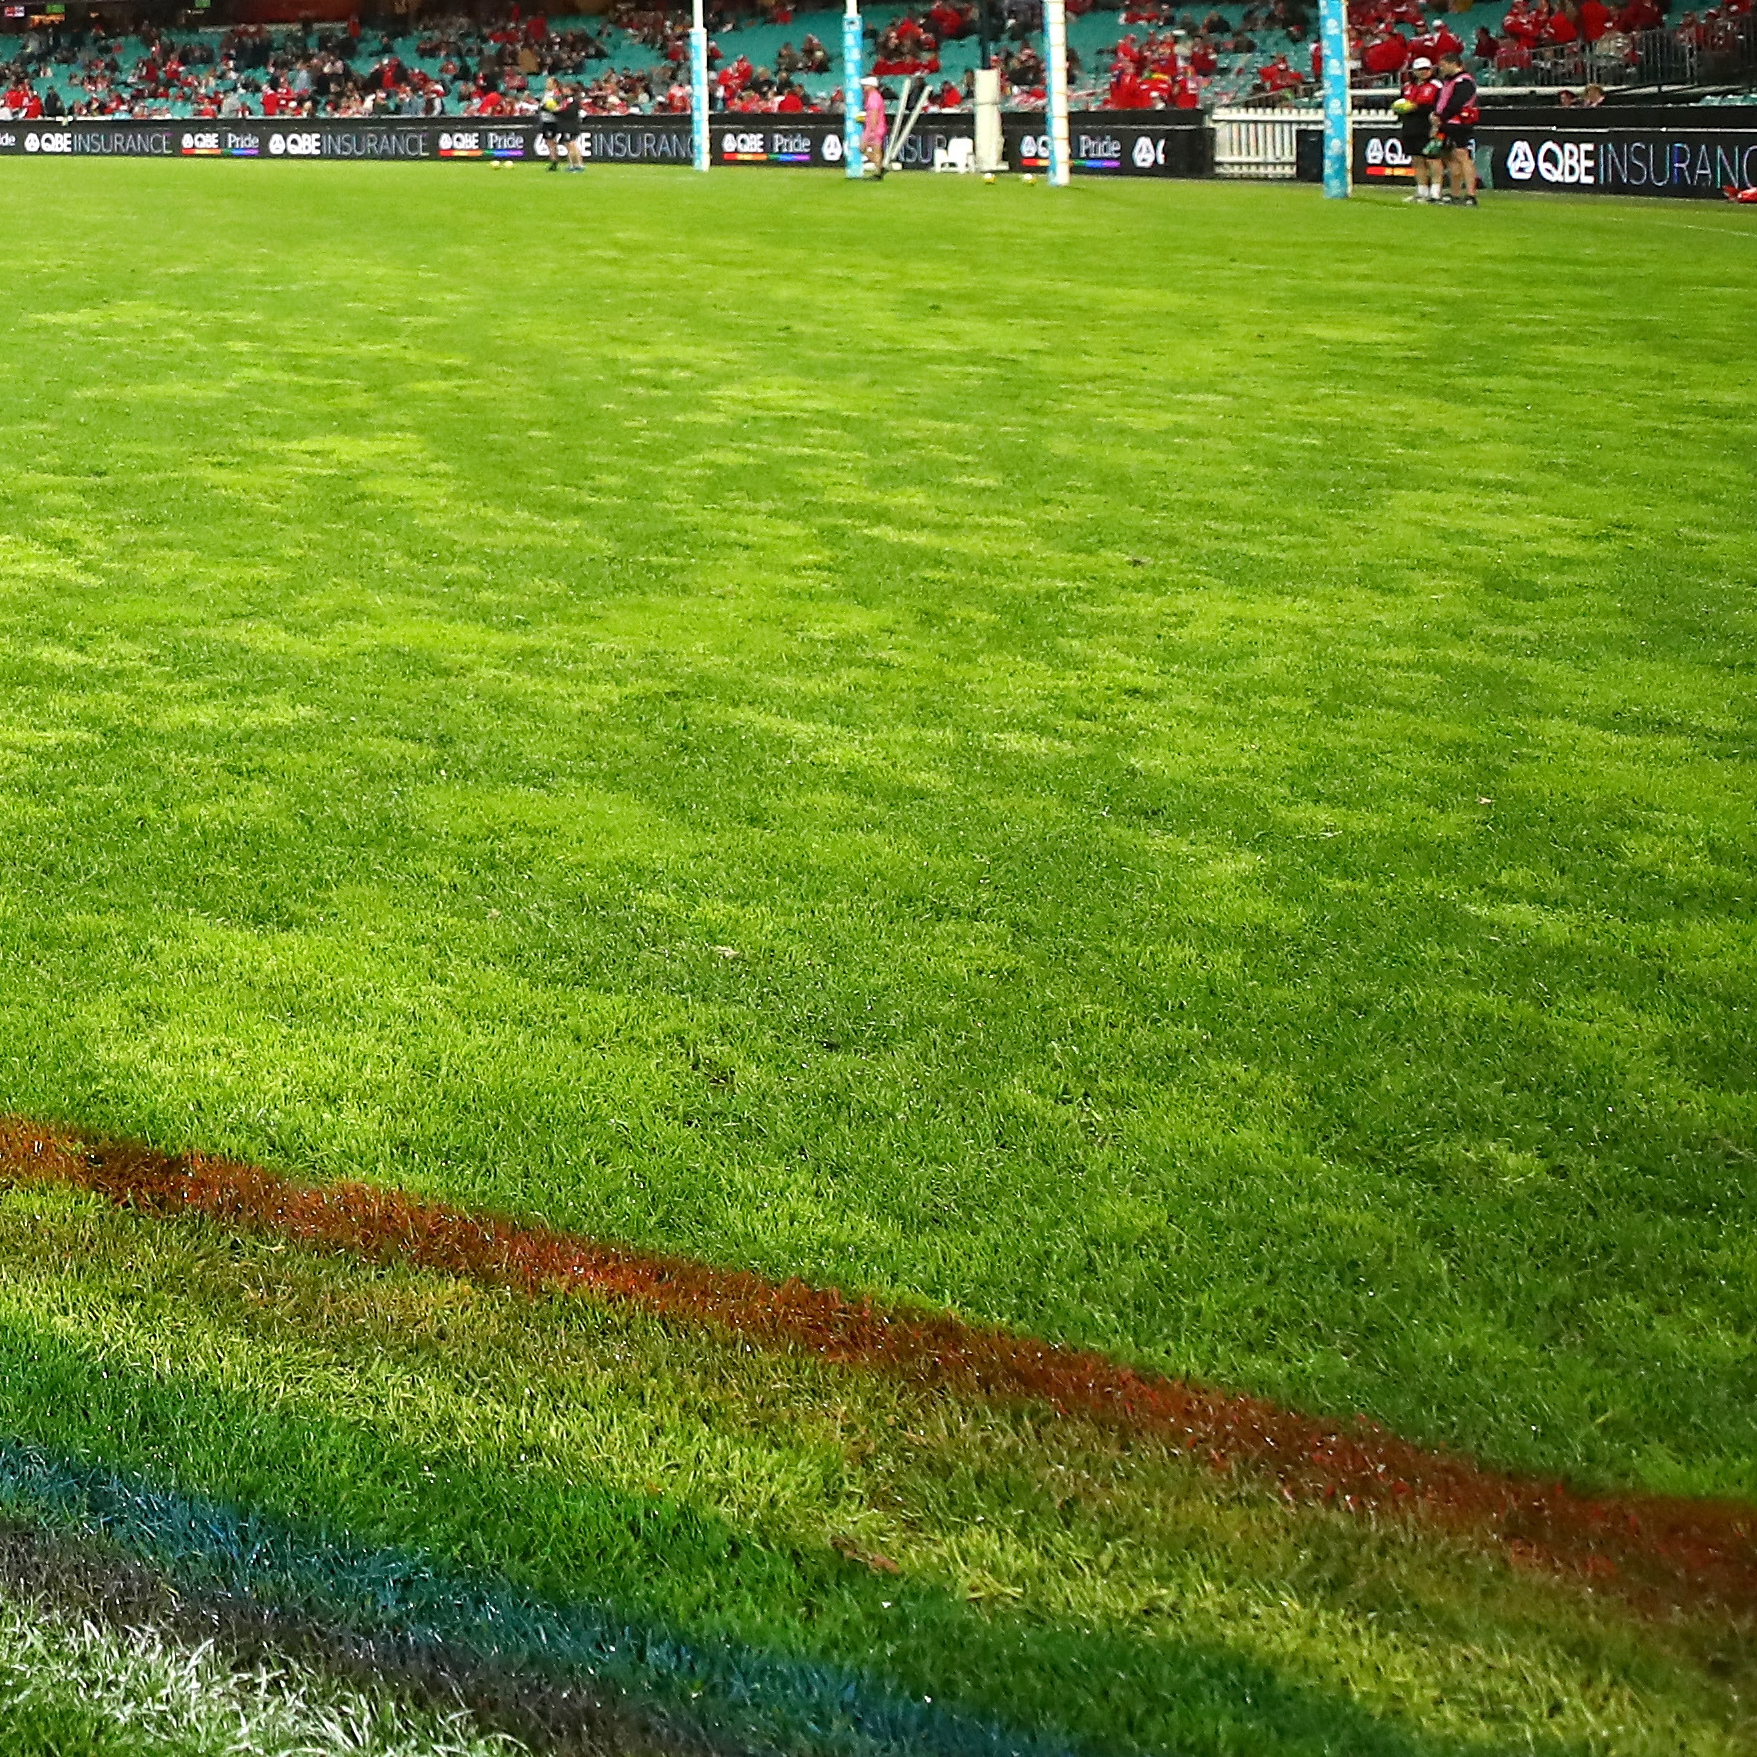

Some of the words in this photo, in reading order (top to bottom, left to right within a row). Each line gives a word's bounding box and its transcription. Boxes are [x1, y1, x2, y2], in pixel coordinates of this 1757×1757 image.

[41, 133, 72, 151] QBE
[73, 132, 173, 153] INSURANCE
[194, 133, 218, 148] QBE
[228, 133, 259, 148] Pride
[287, 133, 320, 155] QBE
[321, 132, 429, 156] INSURANCE
[453, 132, 479, 149] QBE
[488, 132, 524, 149] Pride
[594, 133, 693, 158] INSURANC
[737, 133, 763, 151] QBE
[773, 133, 811, 152] Pride
[1079, 135, 1121, 158] Pride
[1537, 140, 1595, 185] QBE
[1597, 142, 1757, 189] INSURANC
